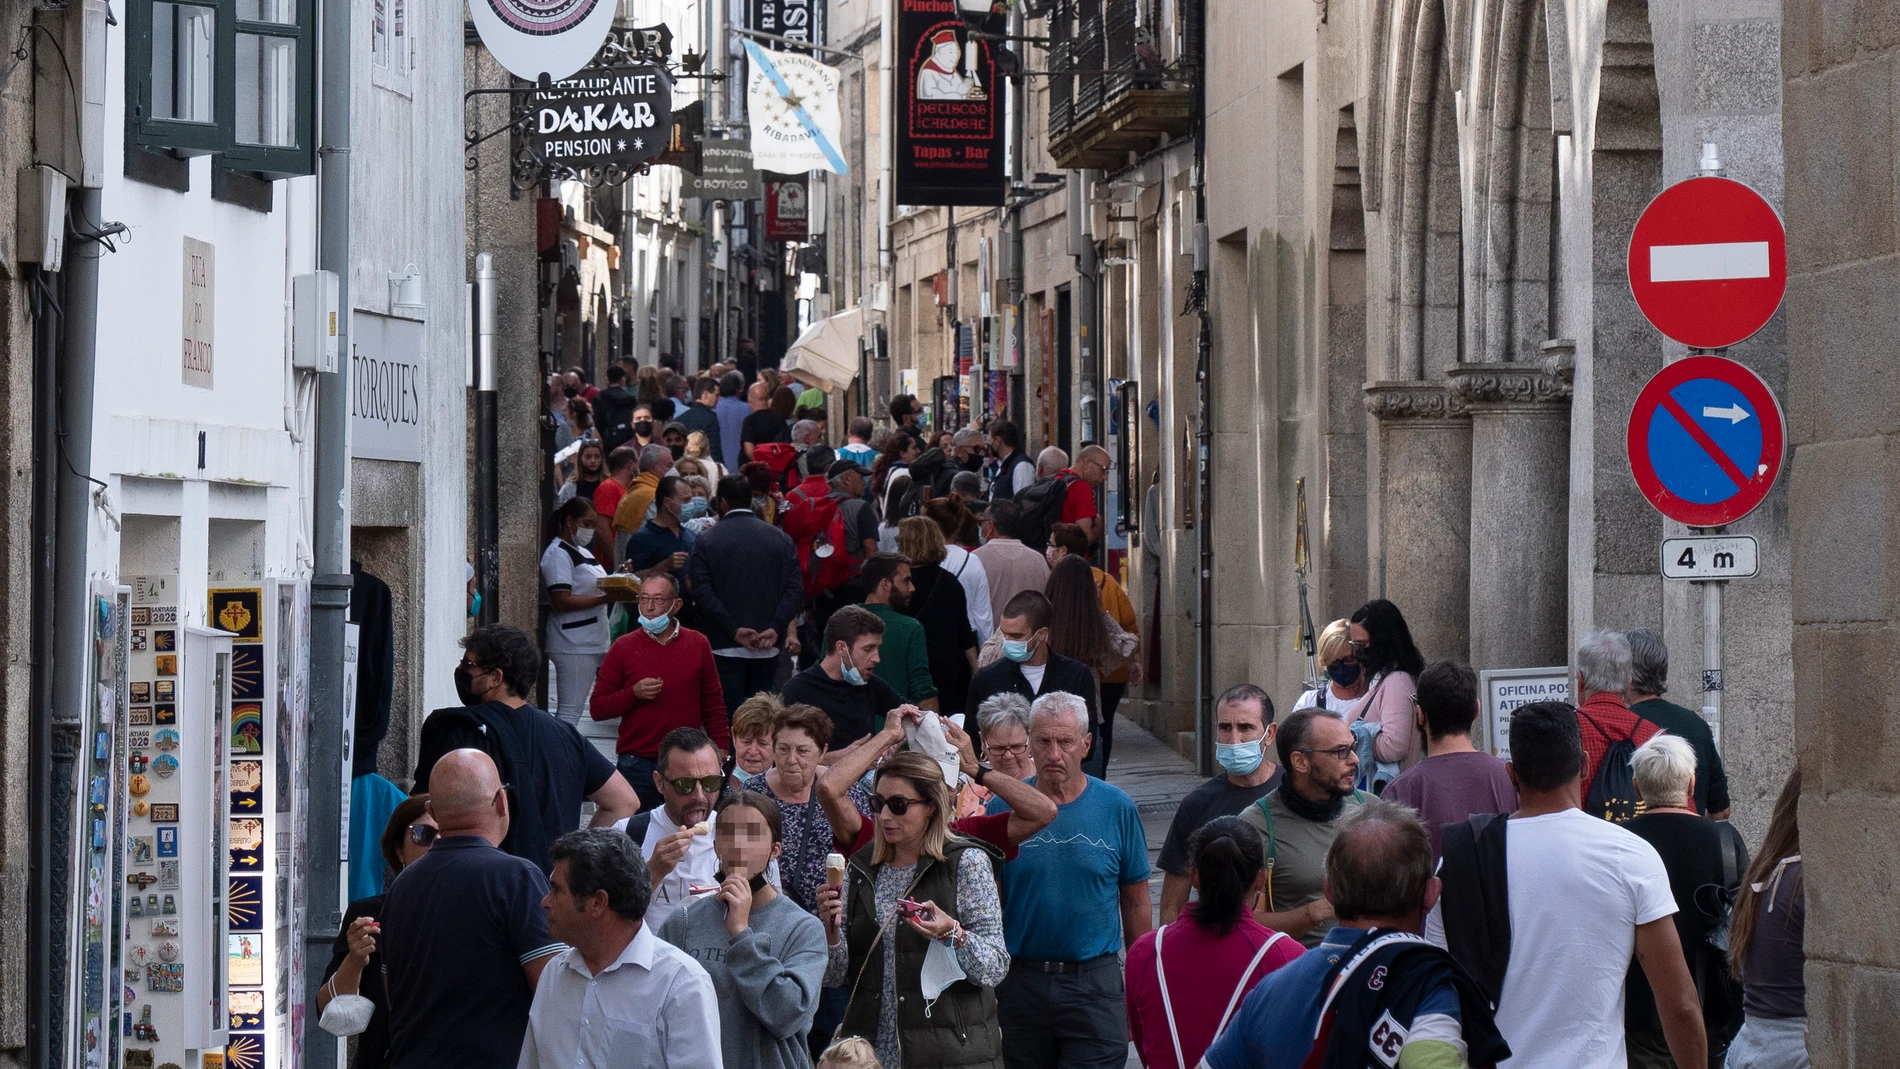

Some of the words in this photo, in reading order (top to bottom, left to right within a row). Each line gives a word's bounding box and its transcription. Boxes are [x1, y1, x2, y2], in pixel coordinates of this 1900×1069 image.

[903, 0, 955, 12] Pinchos
[751, 73, 765, 94] BAR
[538, 102, 655, 134] DAKAR
[917, 103, 987, 116] PETISCOS
[921, 117, 986, 130] CARDEAL
[763, 125, 821, 142] RIBADAVI
[545, 138, 611, 157] PENSION
[913, 145, 952, 159] Tapas
[965, 146, 990, 159] Bar
[703, 178, 748, 190] BOTECO
[191, 255, 206, 288] RUA
[195, 302, 202, 324] DO
[184, 338, 212, 374] FRANCO
[352, 343, 419, 430] TORQUES
[1677, 547, 1696, 569] 4
[1713, 552, 1734, 568] m
[153, 612, 177, 623] 2020
[1499, 685, 1546, 696] OFICINA
[130, 714, 148, 723] 2019
